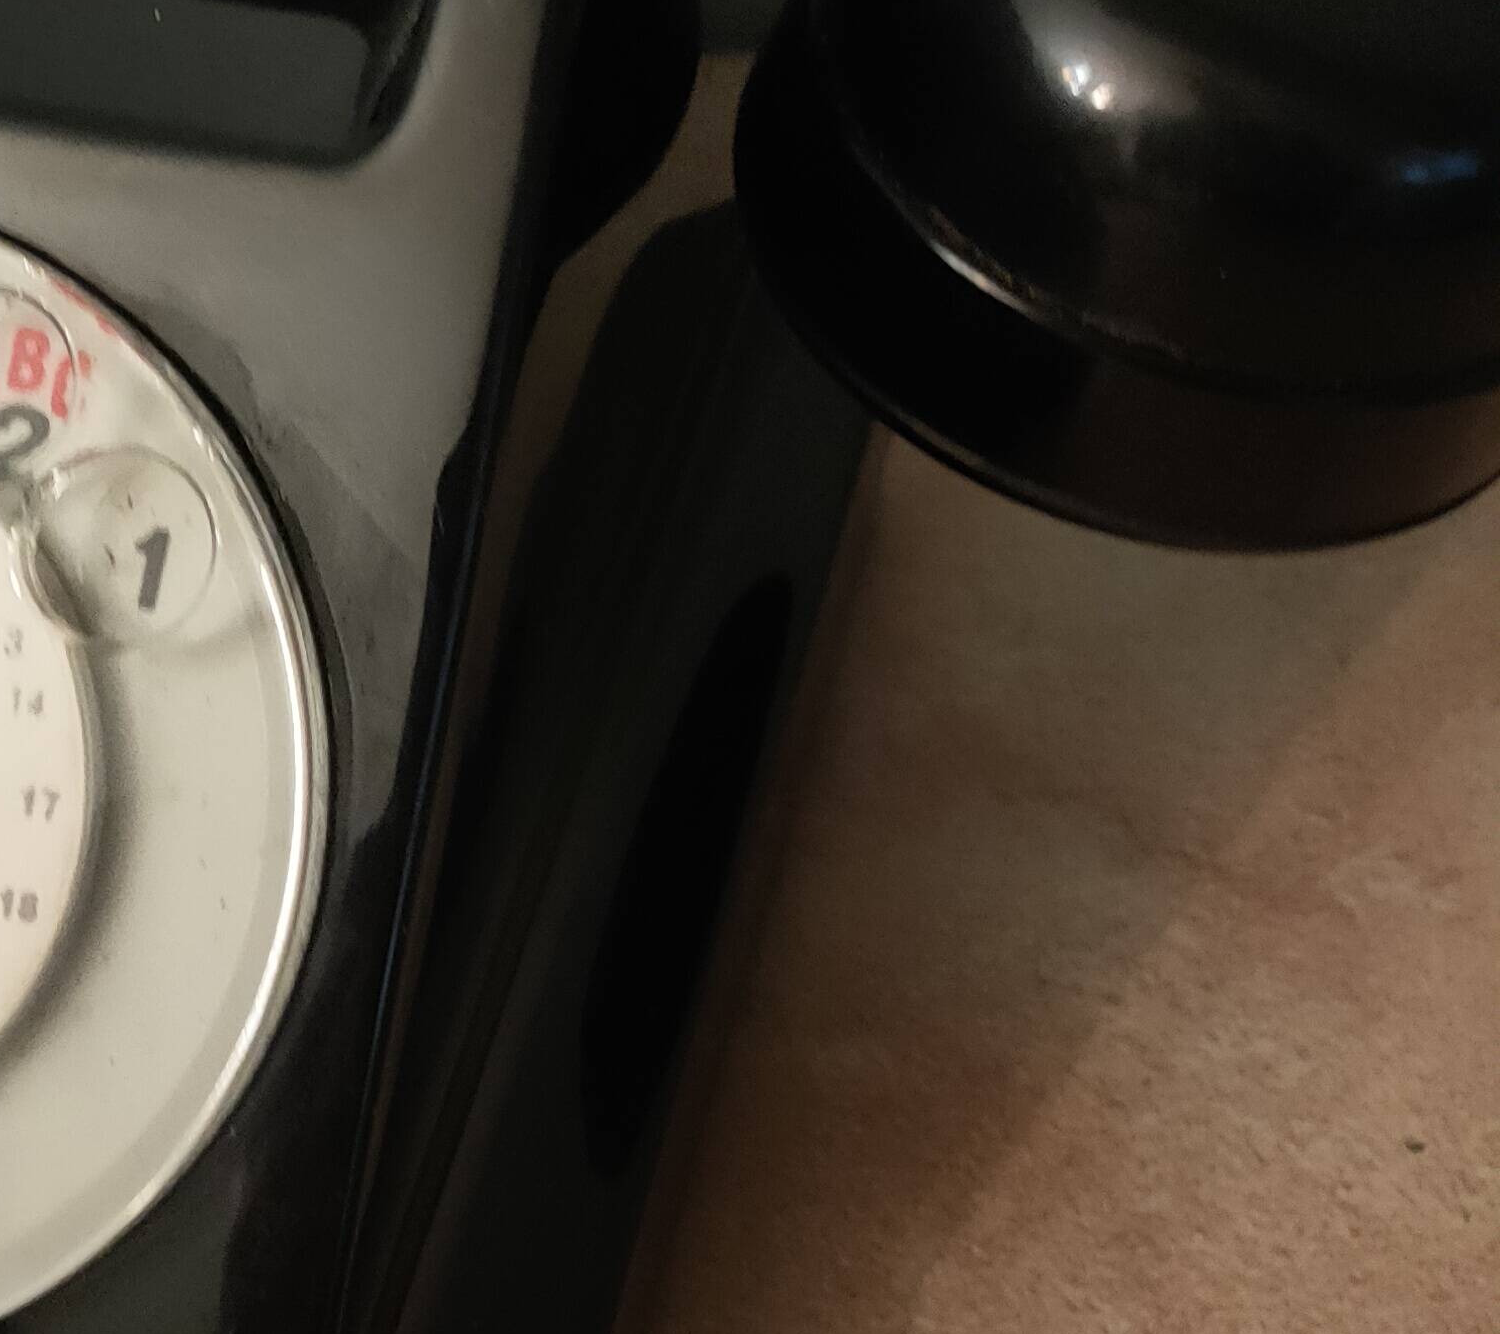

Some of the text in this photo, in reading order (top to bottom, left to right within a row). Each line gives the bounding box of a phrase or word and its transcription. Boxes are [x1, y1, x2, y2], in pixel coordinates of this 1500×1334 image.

[134, 527, 170, 612] 1
[13, 687, 43, 715] 14
[22, 785, 60, 821] 17
